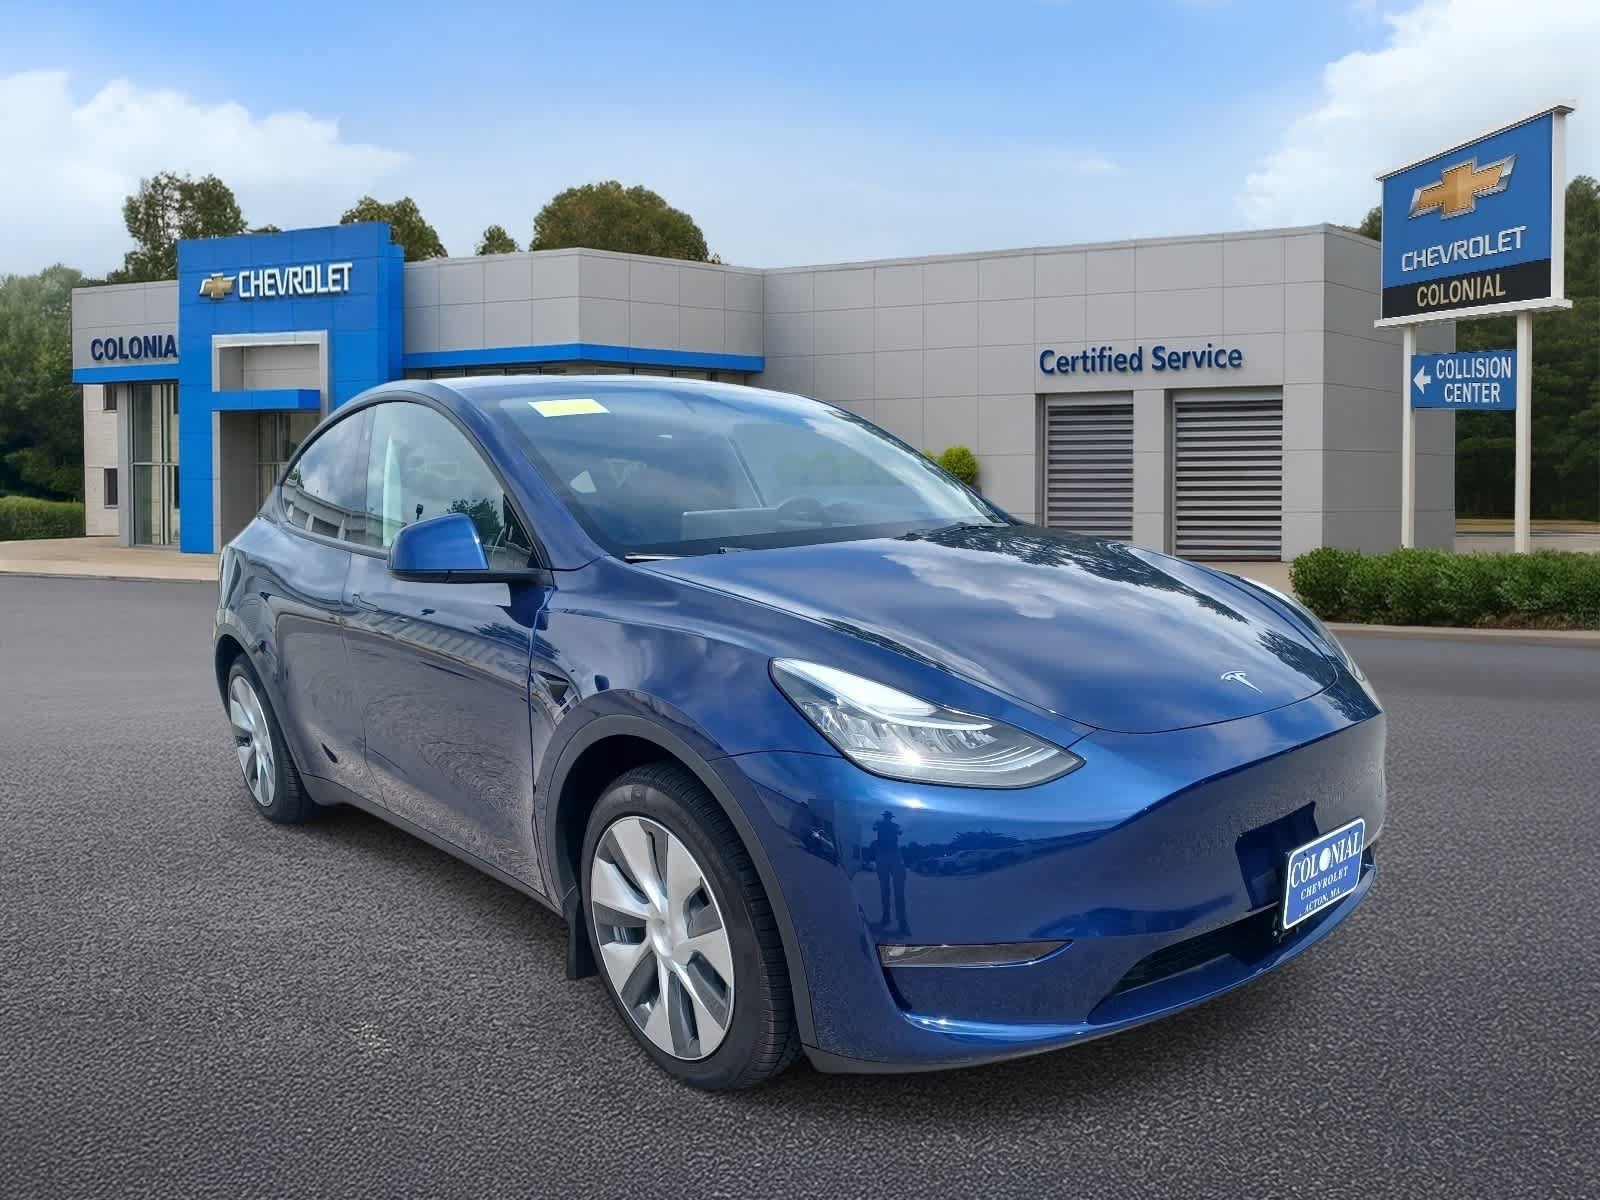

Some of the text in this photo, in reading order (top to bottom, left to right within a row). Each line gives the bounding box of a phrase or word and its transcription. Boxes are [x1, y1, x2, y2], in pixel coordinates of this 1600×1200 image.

[1401, 225, 1527, 271] CHEVROLET
[238, 262, 352, 298] CHEVROLET
[1417, 273, 1506, 307] COLONIAL
[1039, 342, 1243, 375] Certified Service
[1436, 355, 1512, 380] COLLISION
[1444, 382, 1501, 403] CENTER
[1301, 865, 1348, 900] CHEVROLET
[1330, 887, 1341, 900] MA
